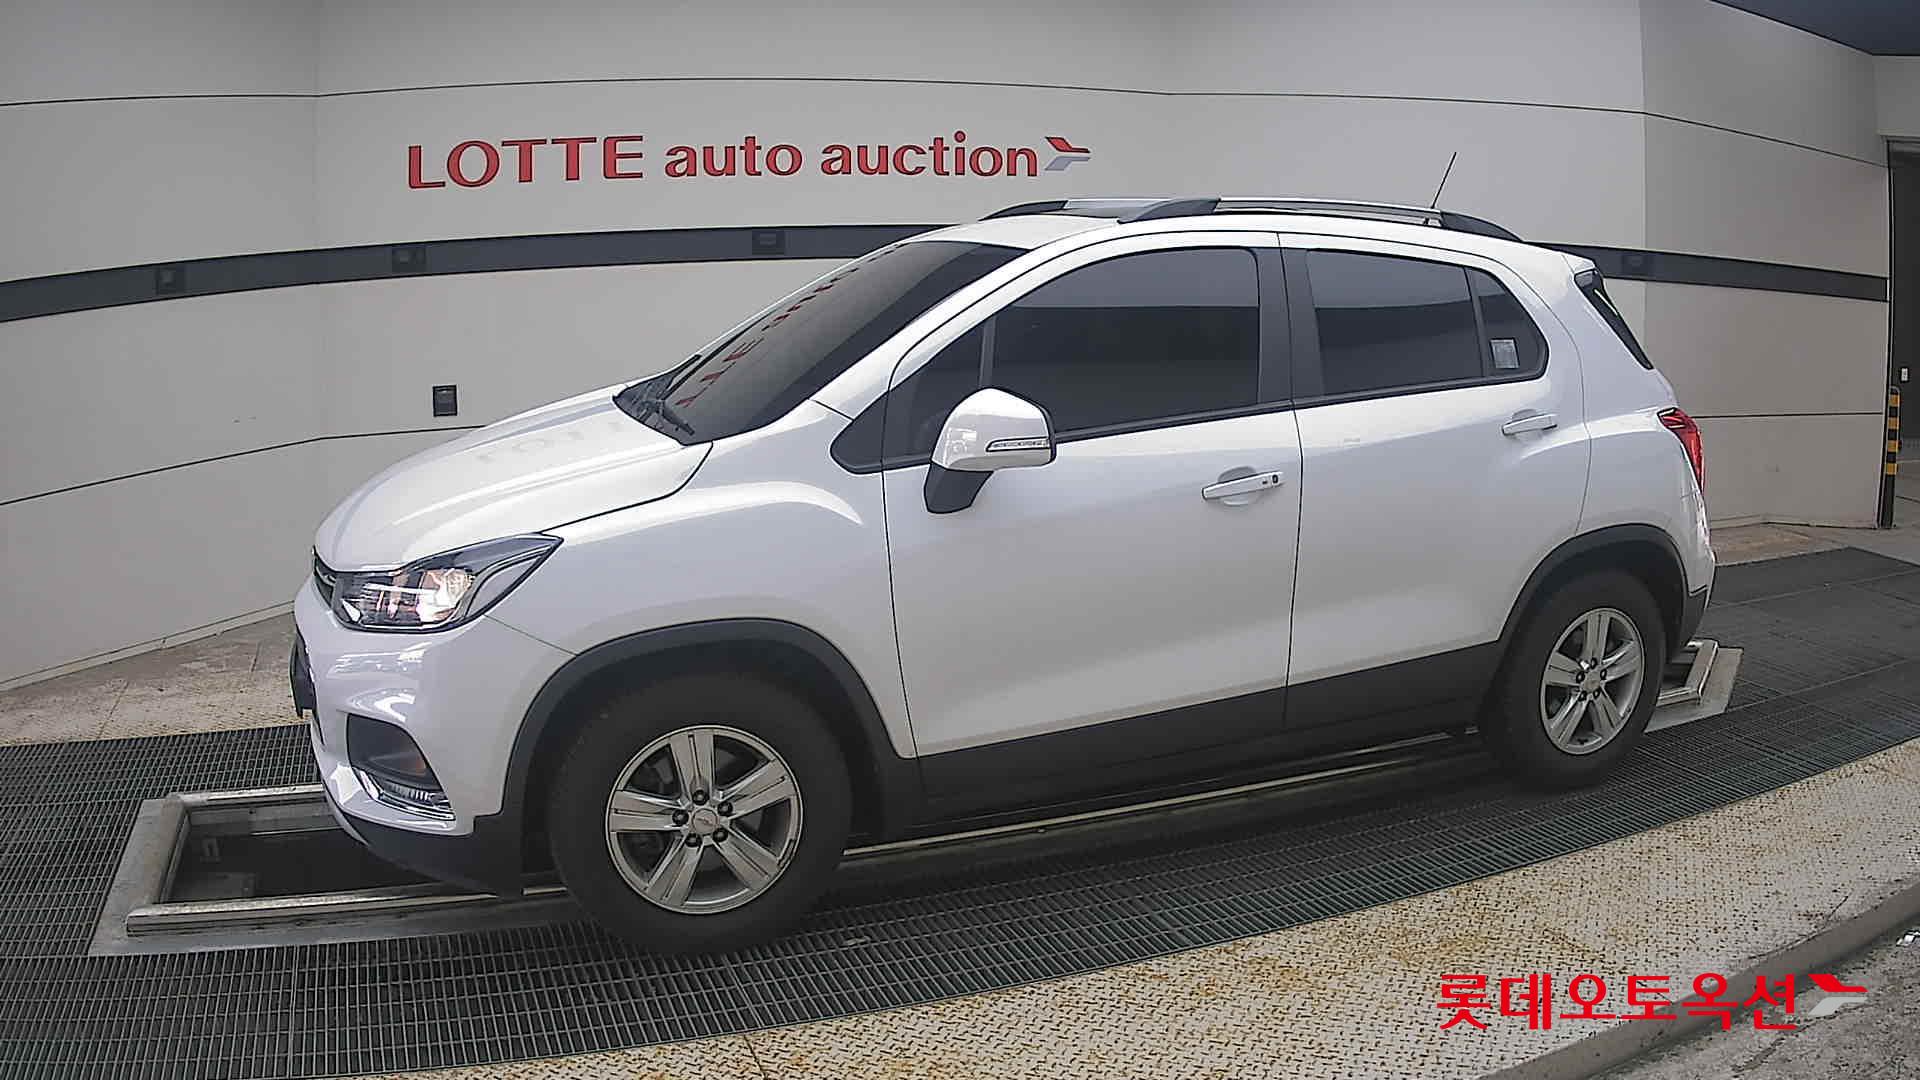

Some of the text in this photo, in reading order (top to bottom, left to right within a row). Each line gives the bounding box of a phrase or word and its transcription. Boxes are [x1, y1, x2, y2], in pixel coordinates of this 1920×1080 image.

[407, 131, 1039, 189] LOTTE auto auction
